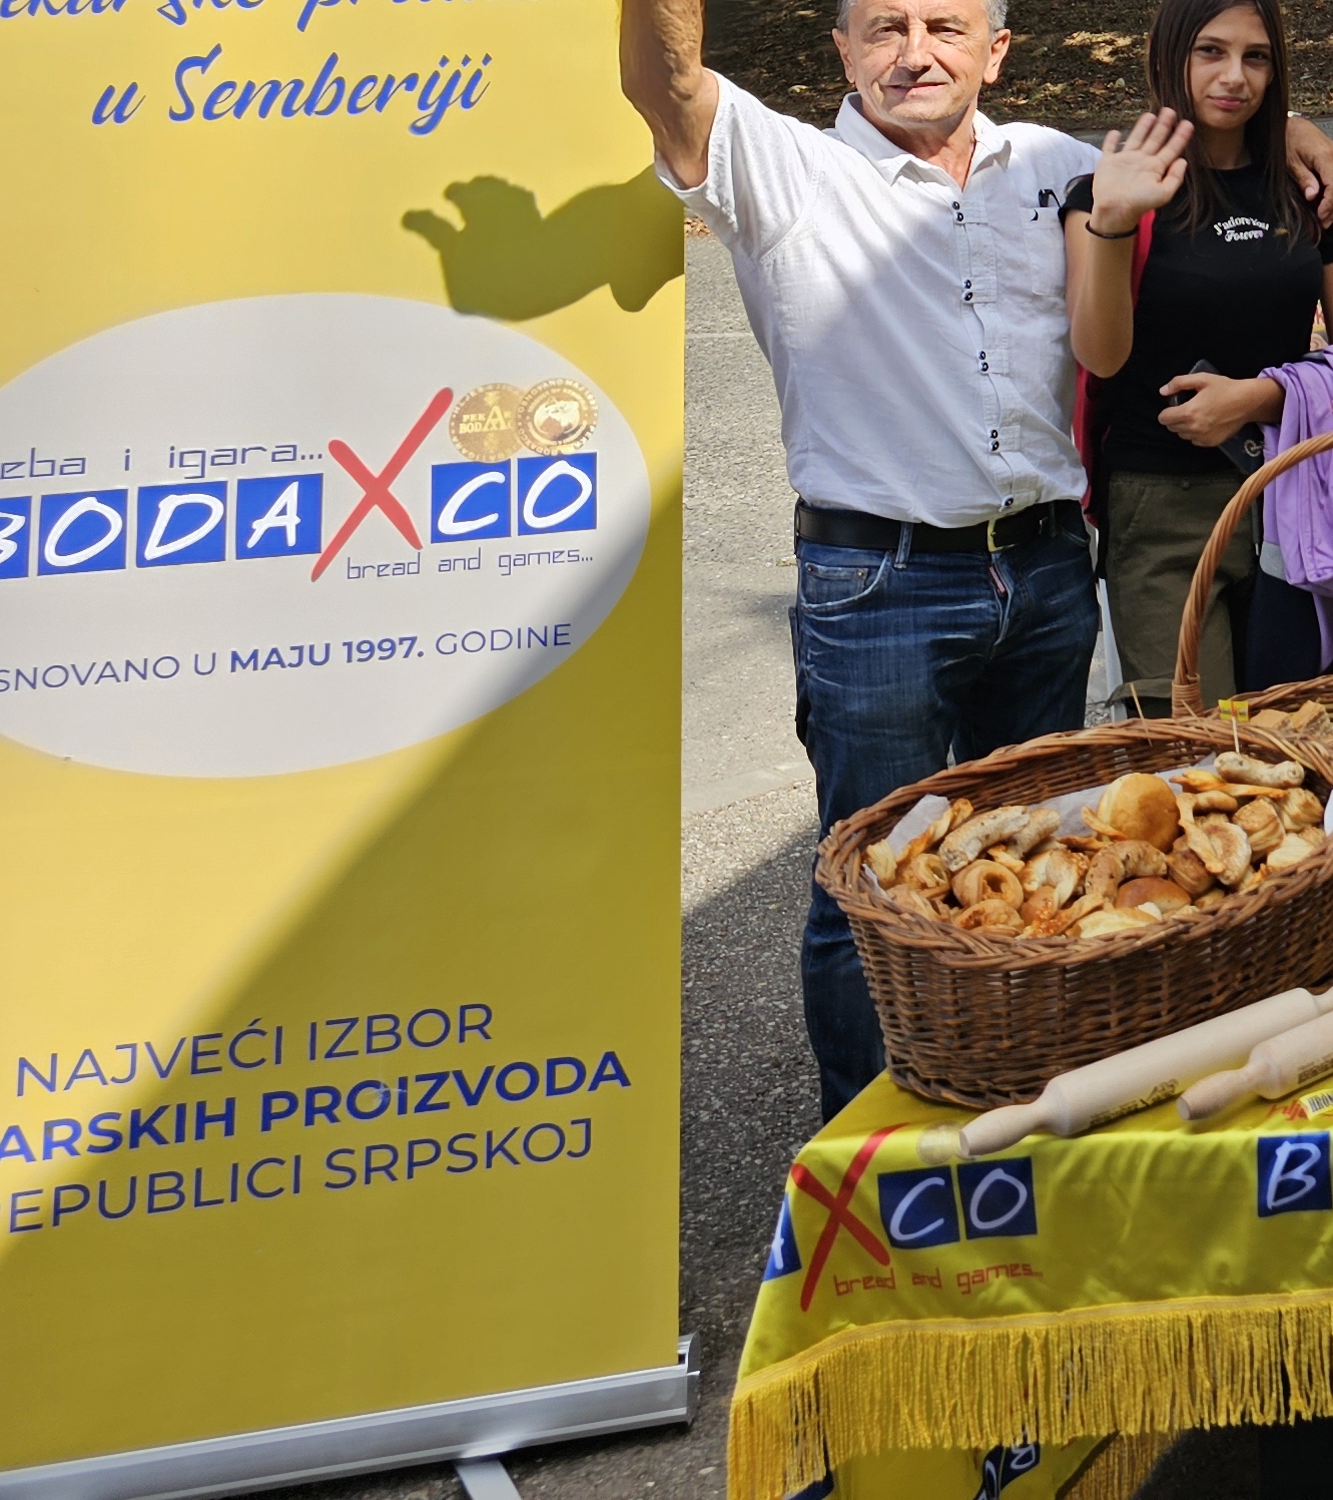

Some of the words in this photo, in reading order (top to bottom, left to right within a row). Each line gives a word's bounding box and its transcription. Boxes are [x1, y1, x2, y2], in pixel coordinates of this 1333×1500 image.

[91, 75, 147, 126] u
[0, 447, 87, 481] eba
[123, 448, 131, 472] i
[168, 439, 325, 482] igara...
[345, 552, 422, 583] bread
[436, 545, 483, 575] and
[497, 547, 595, 578] games...
[0, 653, 181, 694] SNOVANO
[193, 652, 218, 678] U
[229, 640, 333, 674] MAJU
[341, 632, 427, 665] 1997.
[434, 621, 574, 658] GODINE
[15, 1016, 286, 1099] NAJVEĆI
[308, 1002, 495, 1063] IZBOR
[0, 1094, 237, 1165] ARSKIH
[259, 1049, 632, 1134] PROIZVODA
[0, 1152, 302, 1235] EPUBLICI
[322, 1116, 594, 1192] SRPSKOJ
[832, 1267, 897, 1298] bread
[911, 1266, 943, 1290] and
